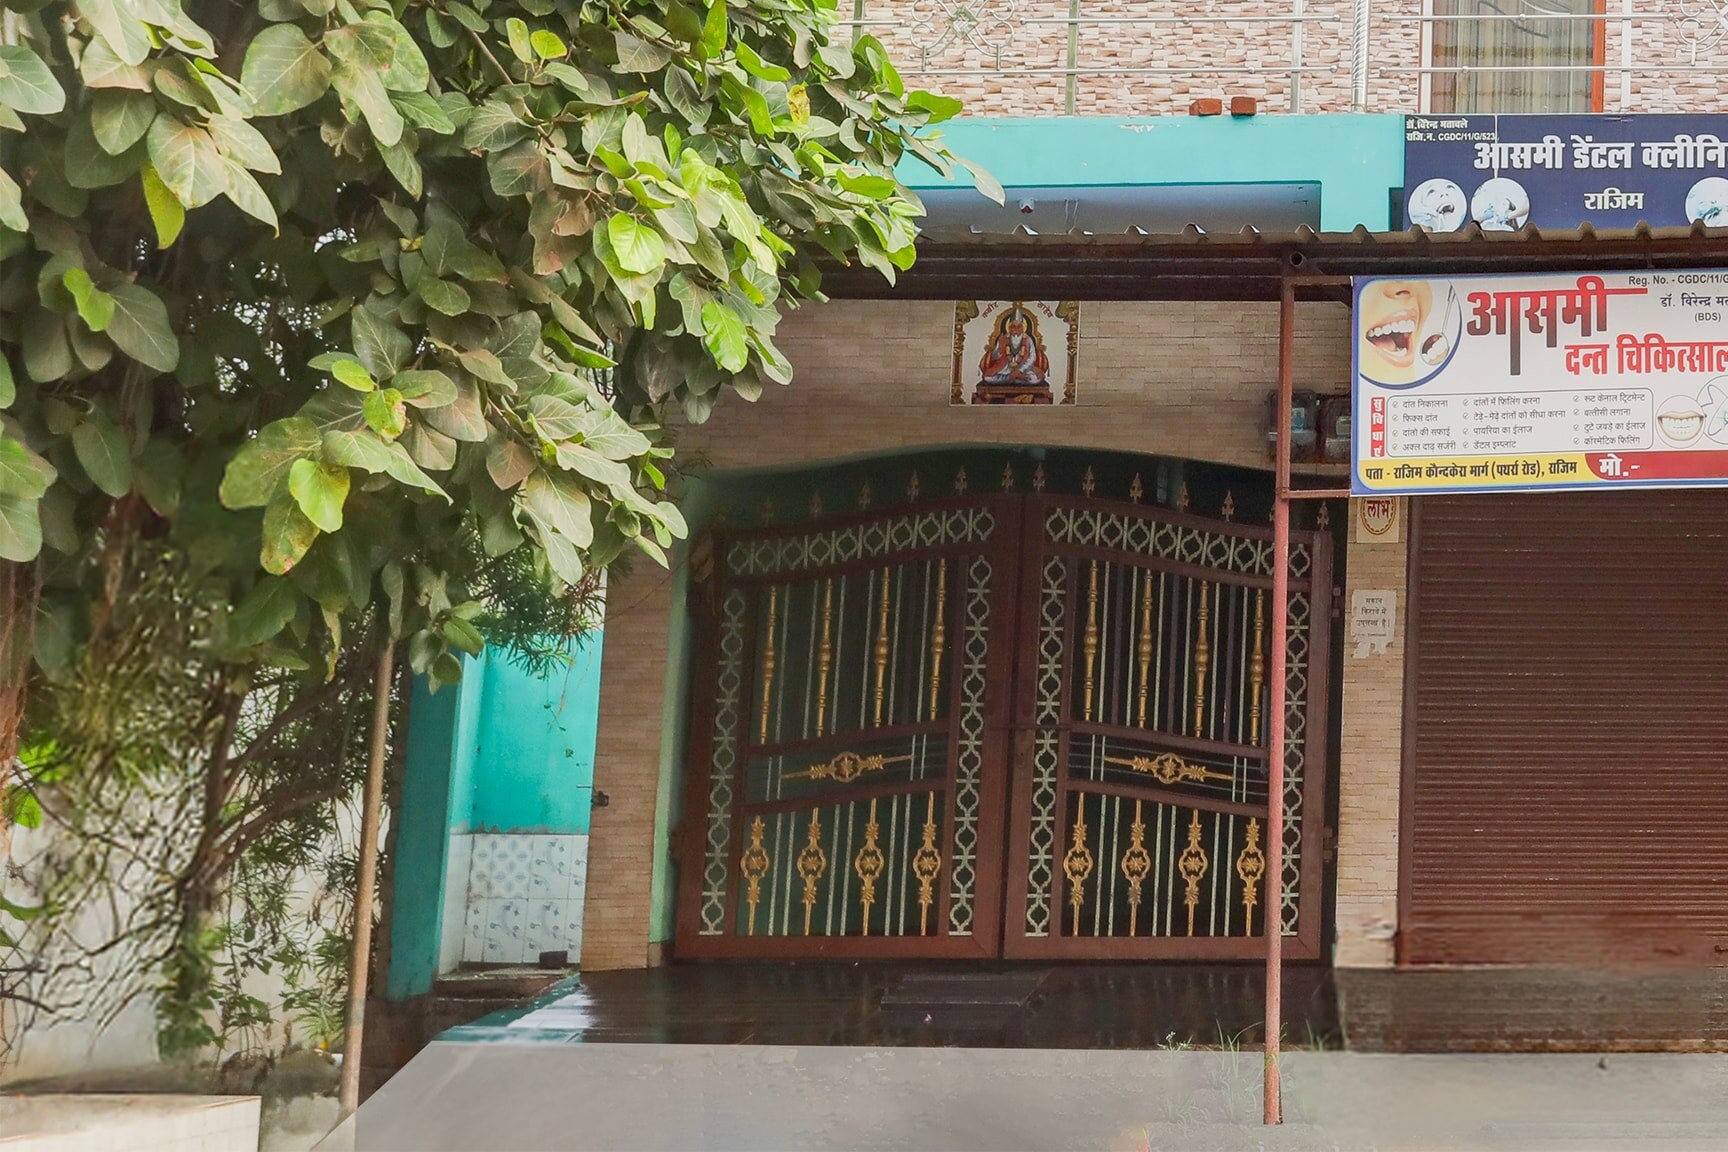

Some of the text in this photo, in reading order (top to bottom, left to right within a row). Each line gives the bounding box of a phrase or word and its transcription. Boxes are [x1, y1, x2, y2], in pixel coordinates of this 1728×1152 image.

[1473, 134, 1566, 170] आसमी
[1571, 134, 1635, 170] डेंटल
[1584, 187, 1645, 210] राजिम
[1628, 275, 1650, 288] Reg.
[1652, 274, 1669, 285] No.
[1660, 292, 1676, 308] डॉ.
[1466, 275, 1648, 376] आसमी
[1694, 312, 1722, 323] (BDS)
[1564, 343, 1610, 376] दन्त
[1365, 467, 1384, 480] पता
[1393, 463, 1423, 479] राजिम
[1470, 461, 1489, 477] मार्ग
[1548, 459, 1578, 474] राजिम
[1367, 499, 1391, 519] लाभ
